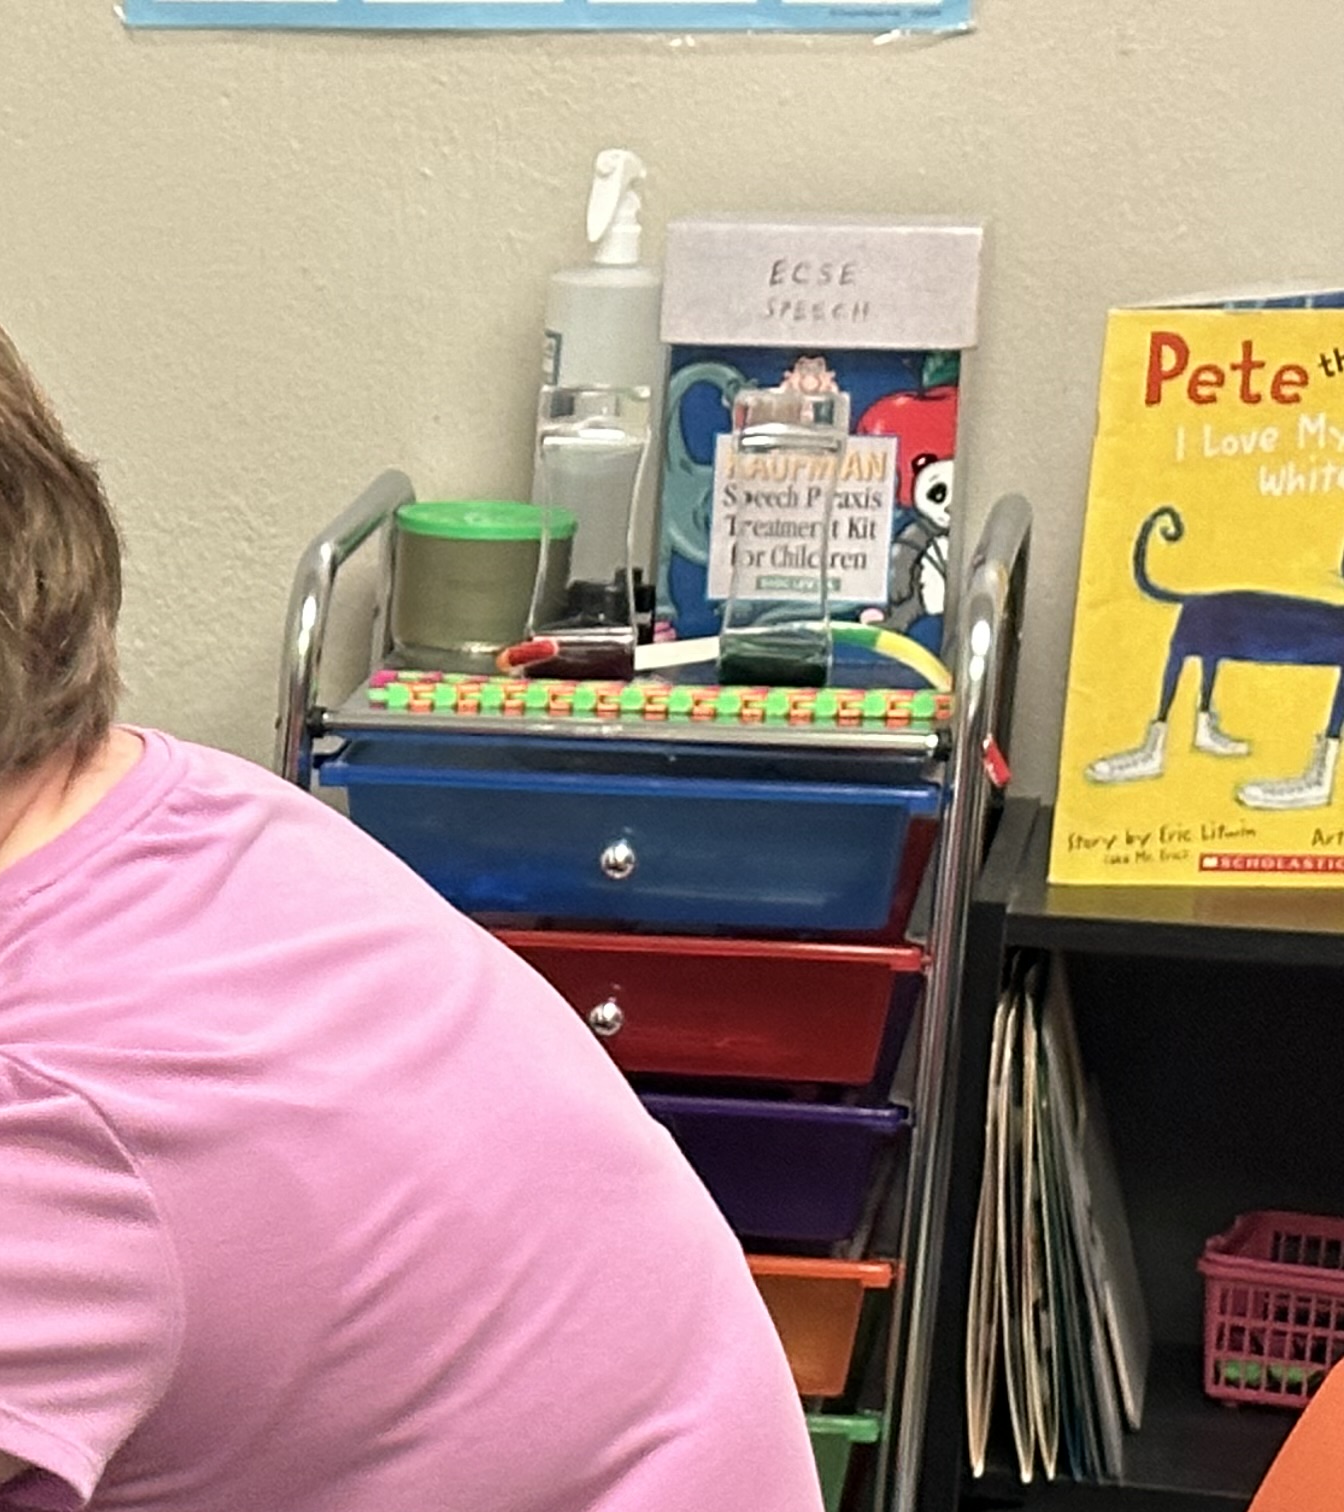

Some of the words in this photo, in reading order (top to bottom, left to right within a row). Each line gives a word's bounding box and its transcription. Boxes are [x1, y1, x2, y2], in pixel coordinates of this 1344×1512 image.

[769, 258, 858, 288] ECSE
[1145, 330, 1310, 407] Pete
[1317, 346, 1344, 379] th
[1175, 424, 1186, 463] I
[1203, 423, 1279, 459] Love
[847, 516, 877, 540] Kit
[1067, 832, 1118, 850] Story
[1125, 829, 1153, 847] by
[1159, 823, 1192, 845] Eric
